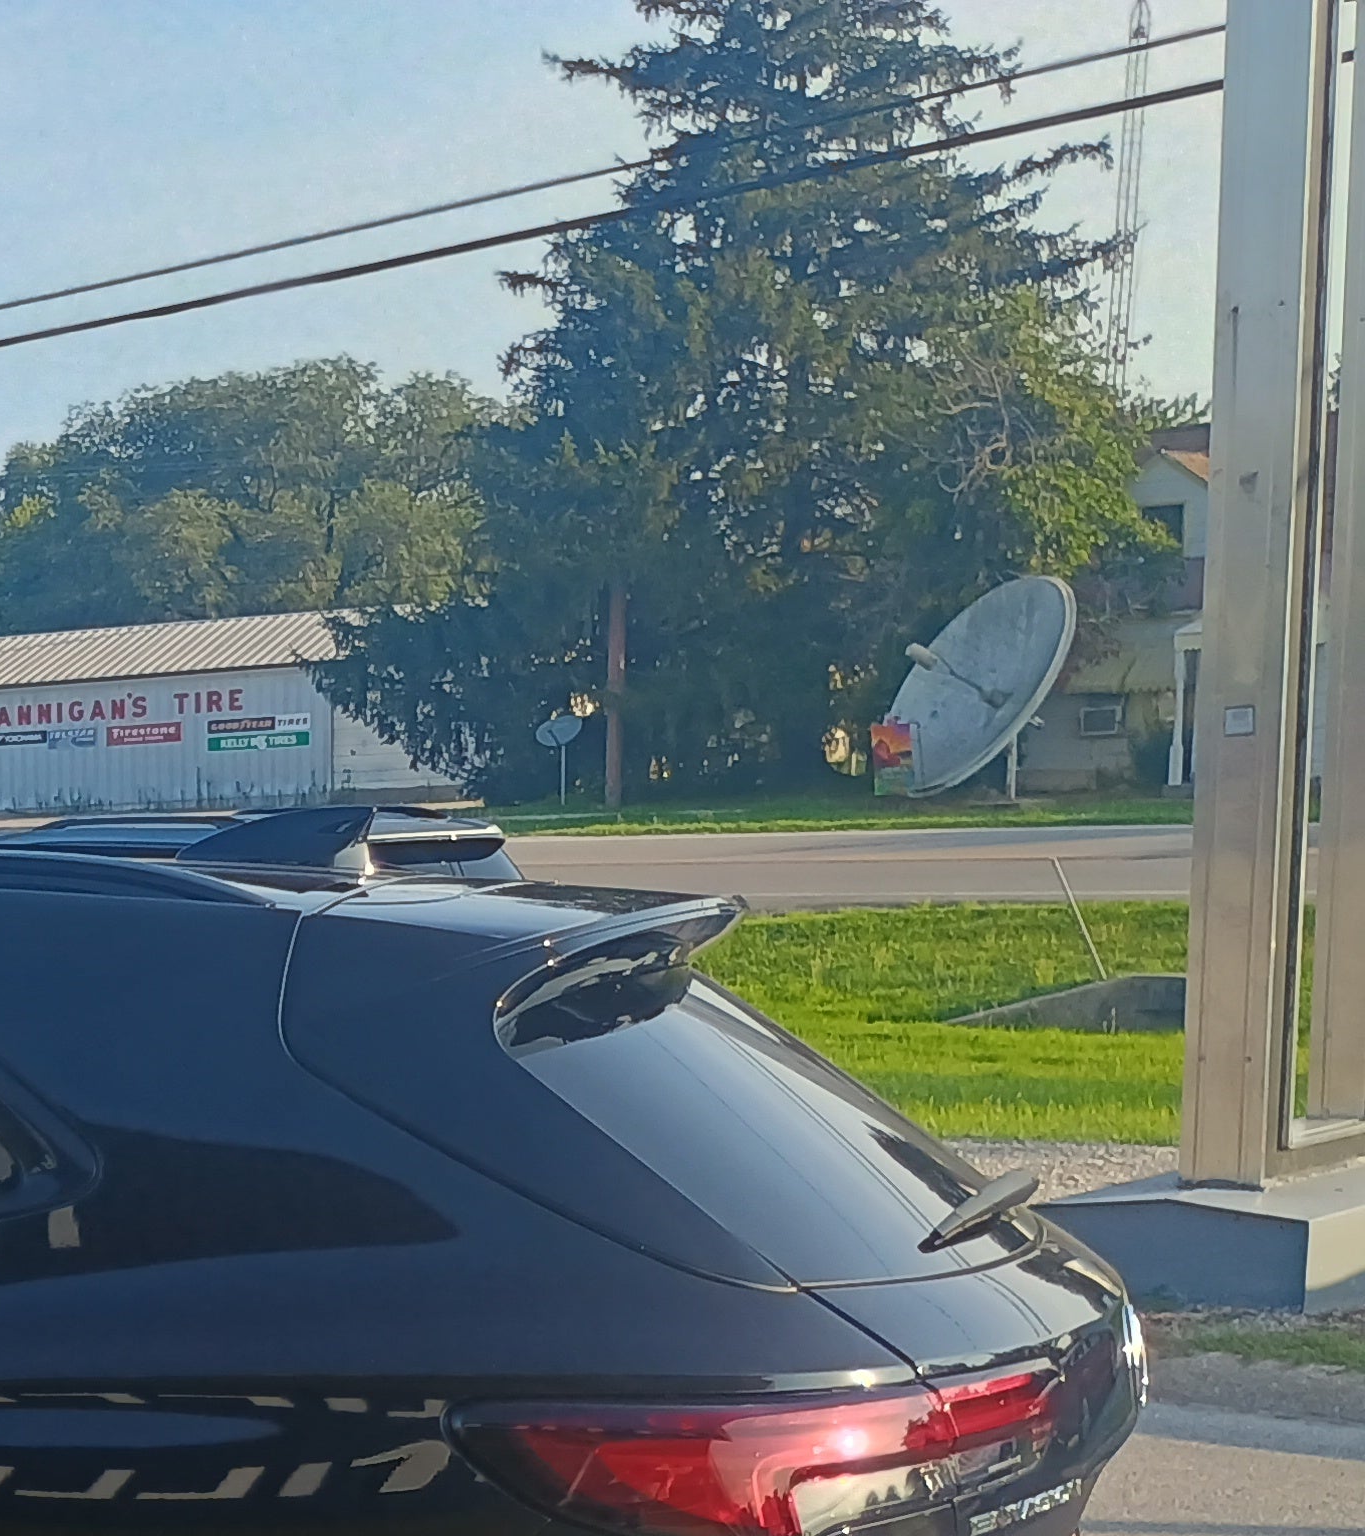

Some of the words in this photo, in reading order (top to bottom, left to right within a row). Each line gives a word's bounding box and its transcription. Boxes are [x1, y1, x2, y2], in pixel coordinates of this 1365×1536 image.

[173, 689, 244, 714] TIRE
[278, 717, 309, 726] TIRES
[112, 726, 176, 739] Firestone
